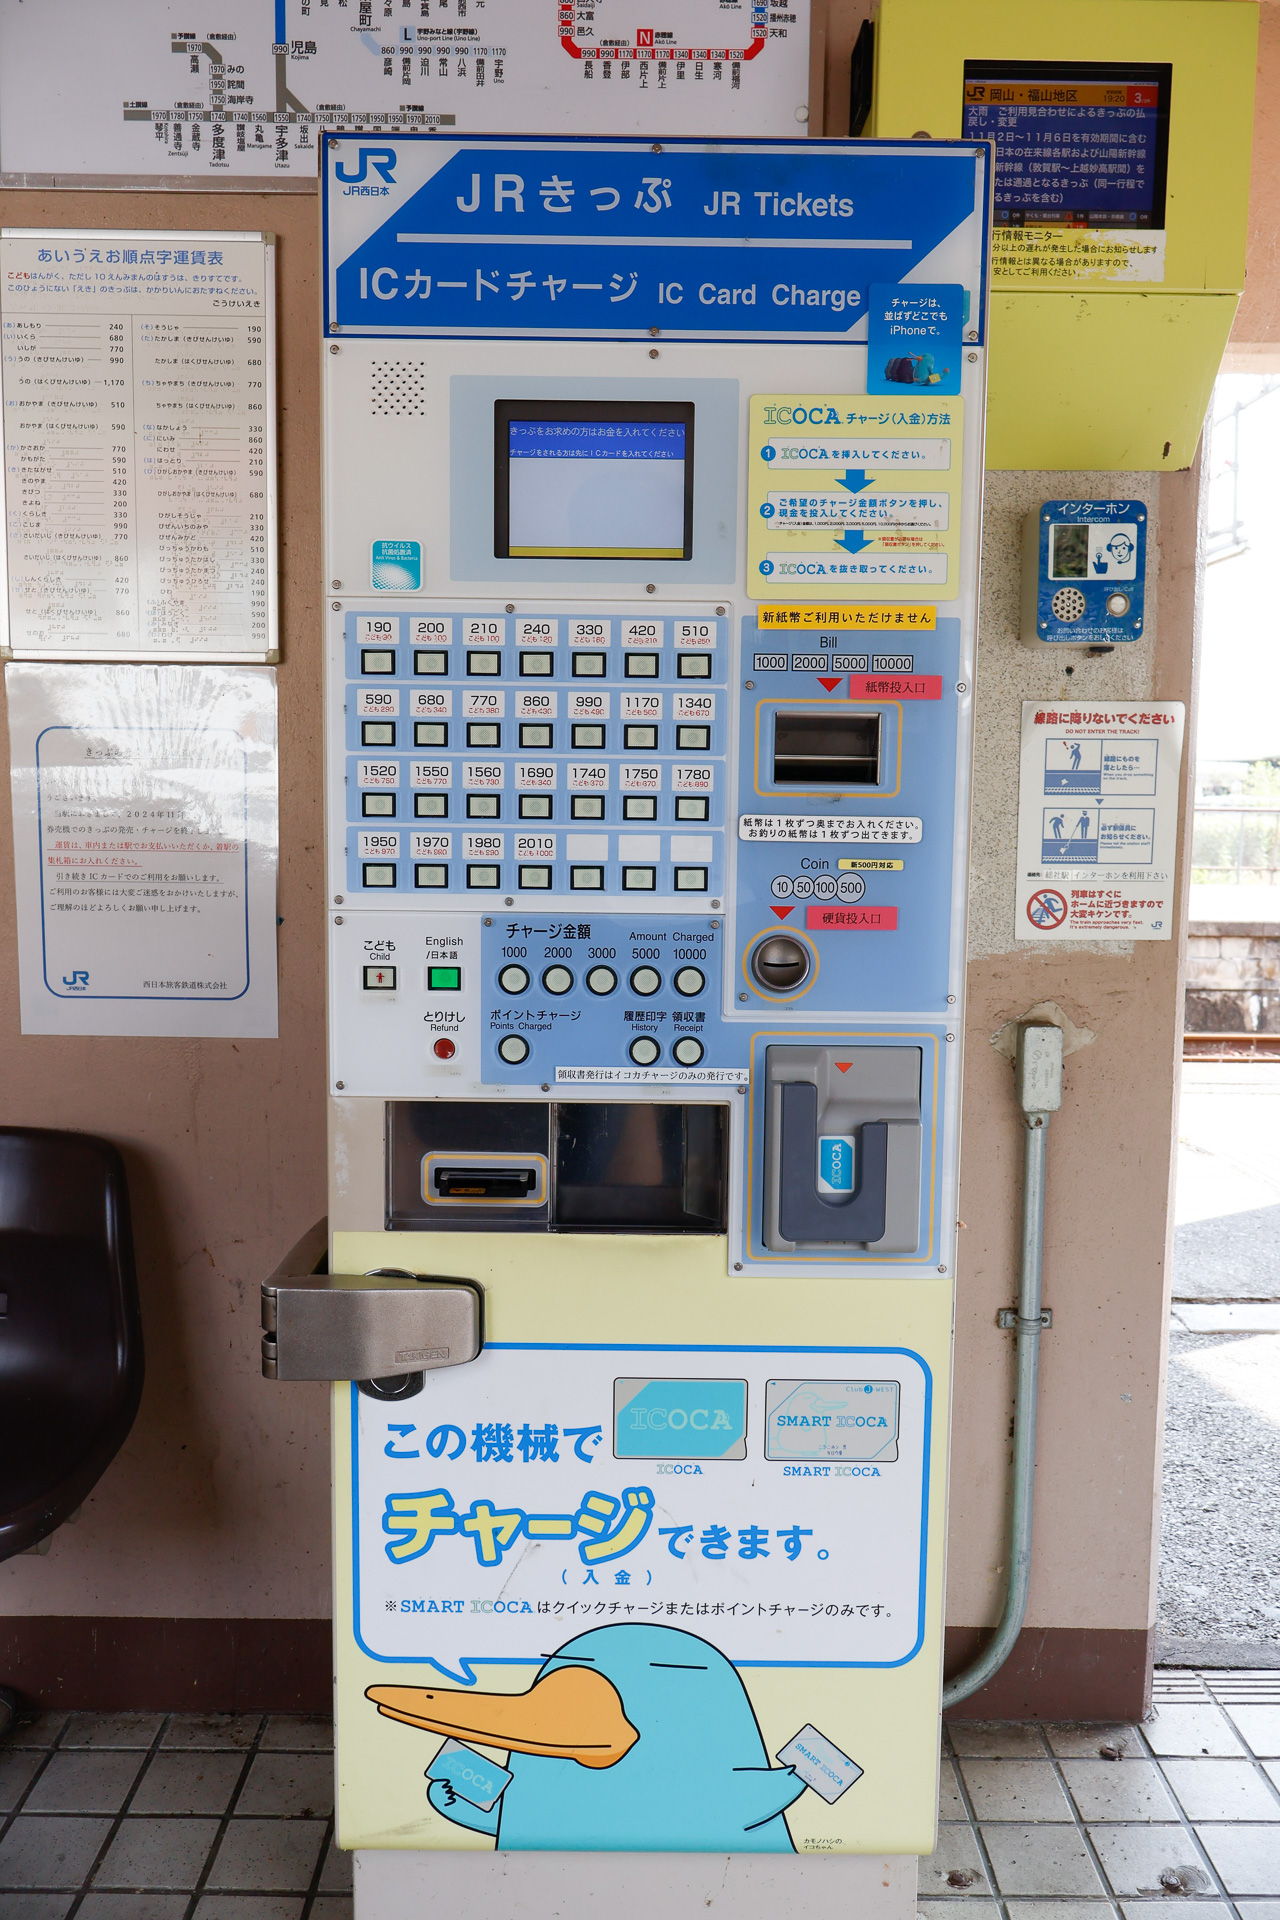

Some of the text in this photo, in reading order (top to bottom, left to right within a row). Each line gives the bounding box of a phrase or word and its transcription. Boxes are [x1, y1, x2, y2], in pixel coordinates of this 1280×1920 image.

[559, 27, 573, 35] 990
[770, 28, 787, 38] 天和
[291, 41, 317, 54] 児島
[494, 59, 503, 78] 宇野
[967, 86, 985, 97] JR
[990, 88, 1078, 102] 岡山・福山地区
[227, 95, 254, 104] 海岸寺
[1103, 95, 1126, 103] 19:20
[968, 117, 1017, 127] 戻し・変更
[300, 125, 308, 143] 坂出
[212, 124, 225, 161] 多度津
[275, 125, 288, 161] 宇多津
[335, 147, 397, 184] JR
[343, 186, 390, 197] JR西日本
[704, 191, 741, 216] JR
[754, 191, 854, 217] Tickets
[37, 248, 224, 266] あいうえお順点字運賃表
[360, 267, 861, 312] ICカードチャージ IC Card Charge
[212, 299, 261, 308] ごうけいえき
[891, 298, 941, 308] チャージは、
[884, 311, 948, 321] 並ばずどこでも
[109, 323, 124, 331] 240
[890, 324, 941, 335] iPhoneで。
[510, 426, 686, 438] きっぷをお求めの方はお金を入れてください
[779, 498, 943, 509] ご希望のチャージ金額ボタンを押し、
[1058, 503, 1130, 515] インターホン
[779, 509, 894, 518] 現金を投入してください。
[762, 611, 932, 624] 新紙幣ご利用いただけません
[366, 622, 392, 633] 190
[418, 622, 445, 633] 200
[471, 623, 497, 634] 210
[576, 624, 603, 635] 330
[629, 625, 656, 636] 420
[682, 625, 709, 636] 510
[820, 636, 838, 648] Bill
[756, 657, 785, 668] 1000
[794, 657, 826, 668] 2000
[834, 658, 866, 669] 5000
[874, 658, 911, 670] 10000
[865, 681, 925, 693] 紙幣投入口
[365, 694, 392, 705] 590
[418, 695, 445, 705] 680
[471, 695, 497, 706] 770
[523, 696, 550, 707] 860
[626, 697, 660, 708] 1170
[678, 698, 712, 709] 1340
[1033, 711, 1175, 725] 線路に降りないでください
[363, 765, 397, 776] 1520
[415, 766, 449, 777] 1550
[572, 768, 606, 779] 1740
[677, 769, 711, 780] 1780
[743, 818, 919, 829] 紙幣は1枚ずつ奥までお入れください。
[748, 829, 913, 840] お釣りの紙幣は1枚ずつ出てきます。
[363, 837, 397, 847] 1950
[416, 837, 449, 847] 1970
[518, 838, 553, 848] 2010
[47, 857, 139, 866] 集札箱にお入れください。
[800, 857, 829, 870] Coin
[850, 861, 894, 869] 新500円対応
[49, 888, 240, 898] ご利用のお客様には大変ご迷惑をおかけいたしますが、
[776, 882, 788, 893] 10
[796, 882, 811, 893] 50
[816, 882, 835, 893] 100
[840, 882, 862, 894] 500
[1071, 890, 1122, 899] 列車はすぐに
[49, 903, 202, 913] ご理解のほどよろしくお願い申し上げます。
[1071, 900, 1164, 909] ホームに近づきますので
[822, 912, 881, 924] 硬貨投入口
[1070, 910, 1133, 919] 大変キケンです。
[506, 923, 714, 943] チャージ金額 Amount Charged
[363, 940, 396, 951] こども
[425, 936, 464, 947] English
[369, 953, 391, 961] Child
[426, 951, 458, 960] /日本語
[501, 947, 527, 958] 1000
[544, 947, 573, 958] 2000
[588, 948, 616, 958] 3000
[632, 948, 660, 959] 5000
[674, 949, 707, 960] 10000
[62, 970, 90, 986] JR
[143, 980, 228, 990] 西日本旅客鉄道株式会社
[424, 1011, 465, 1022] とりけし
[490, 1009, 582, 1021] ポイントチャージ
[624, 1011, 667, 1022] 履歴印字
[672, 1011, 706, 1022] 領収書
[430, 1024, 459, 1032] Refund
[490, 1022, 552, 1031] Points Charged
[631, 1024, 658, 1033] History
[674, 1024, 704, 1033] Receipt
[557, 1069, 749, 1081] 領収書発行はイコカチャージのみの発行です。
[831, 1142, 842, 1185] ICOCA
[630, 1407, 733, 1431] ICOCA
[777, 1415, 888, 1428] SMART ICOCA
[384, 1423, 603, 1464] この機械で
[656, 1464, 703, 1475] ICOCA
[783, 1466, 881, 1477] SMART ICOCA
[442, 1756, 494, 1795] ICOCA
